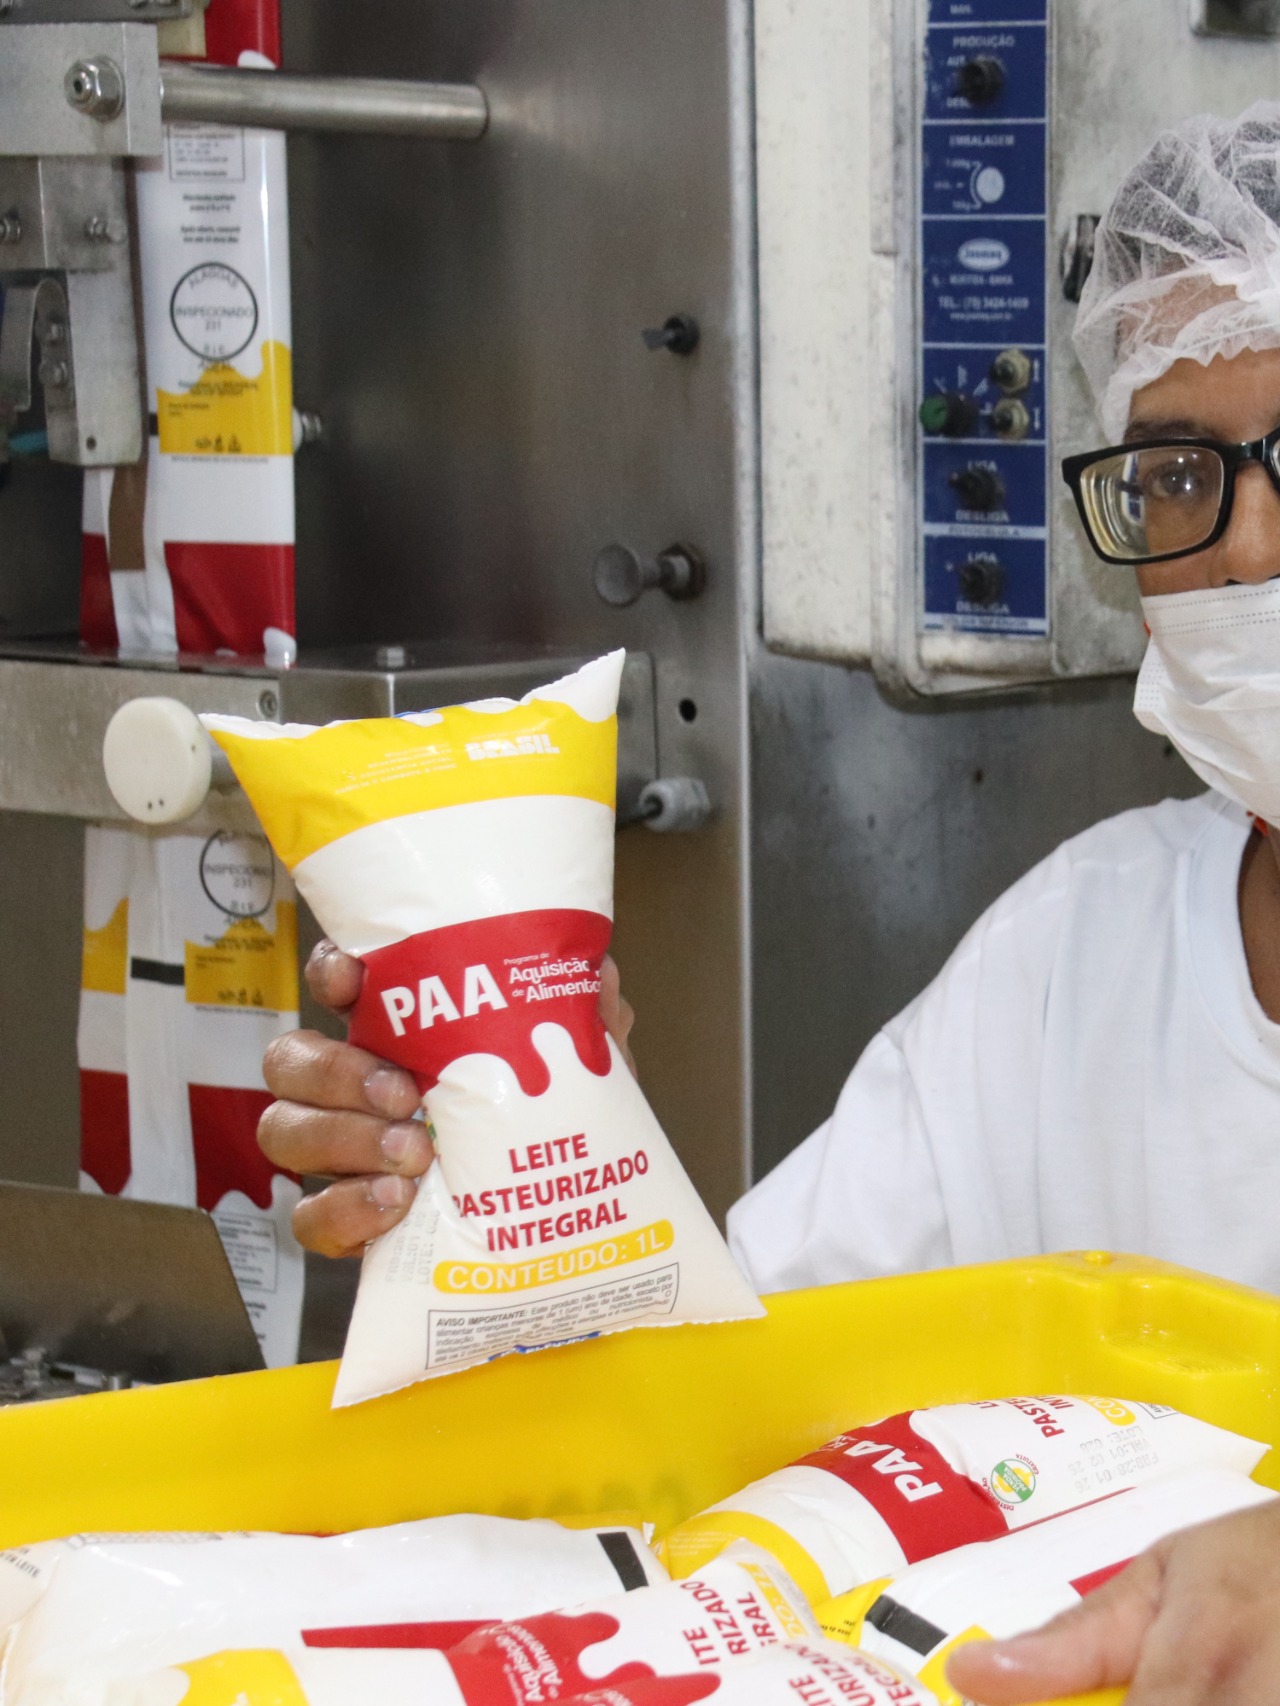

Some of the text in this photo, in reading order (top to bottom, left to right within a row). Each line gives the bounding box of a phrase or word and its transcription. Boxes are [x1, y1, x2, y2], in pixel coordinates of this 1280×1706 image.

[953, 34, 1016, 48] PRODUÇÃO
[949, 134, 1015, 146] EMBALAGEM
[464, 734, 561, 761] BRASIL
[503, 954, 539, 966] Programa
[509, 957, 590, 984] Aquisição
[380, 963, 509, 1037] PAA
[511, 988, 525, 998] de
[508, 1133, 589, 1174] LEITE
[486, 1198, 628, 1252] INTEGRAL
[447, 1227, 666, 1291] CONTEÚDO: 1L
[436, 1317, 465, 1327] AVISO
[468, 1309, 528, 1326] IMPORTANTE:
[551, 1298, 579, 1312] produto
[581, 1293, 596, 1302] não
[598, 1289, 616, 1299] deve
[618, 1285, 630, 1293] ser
[632, 1278, 655, 1290] usado
[656, 1274, 673, 1285] para
[843, 1440, 944, 1503] PAA
